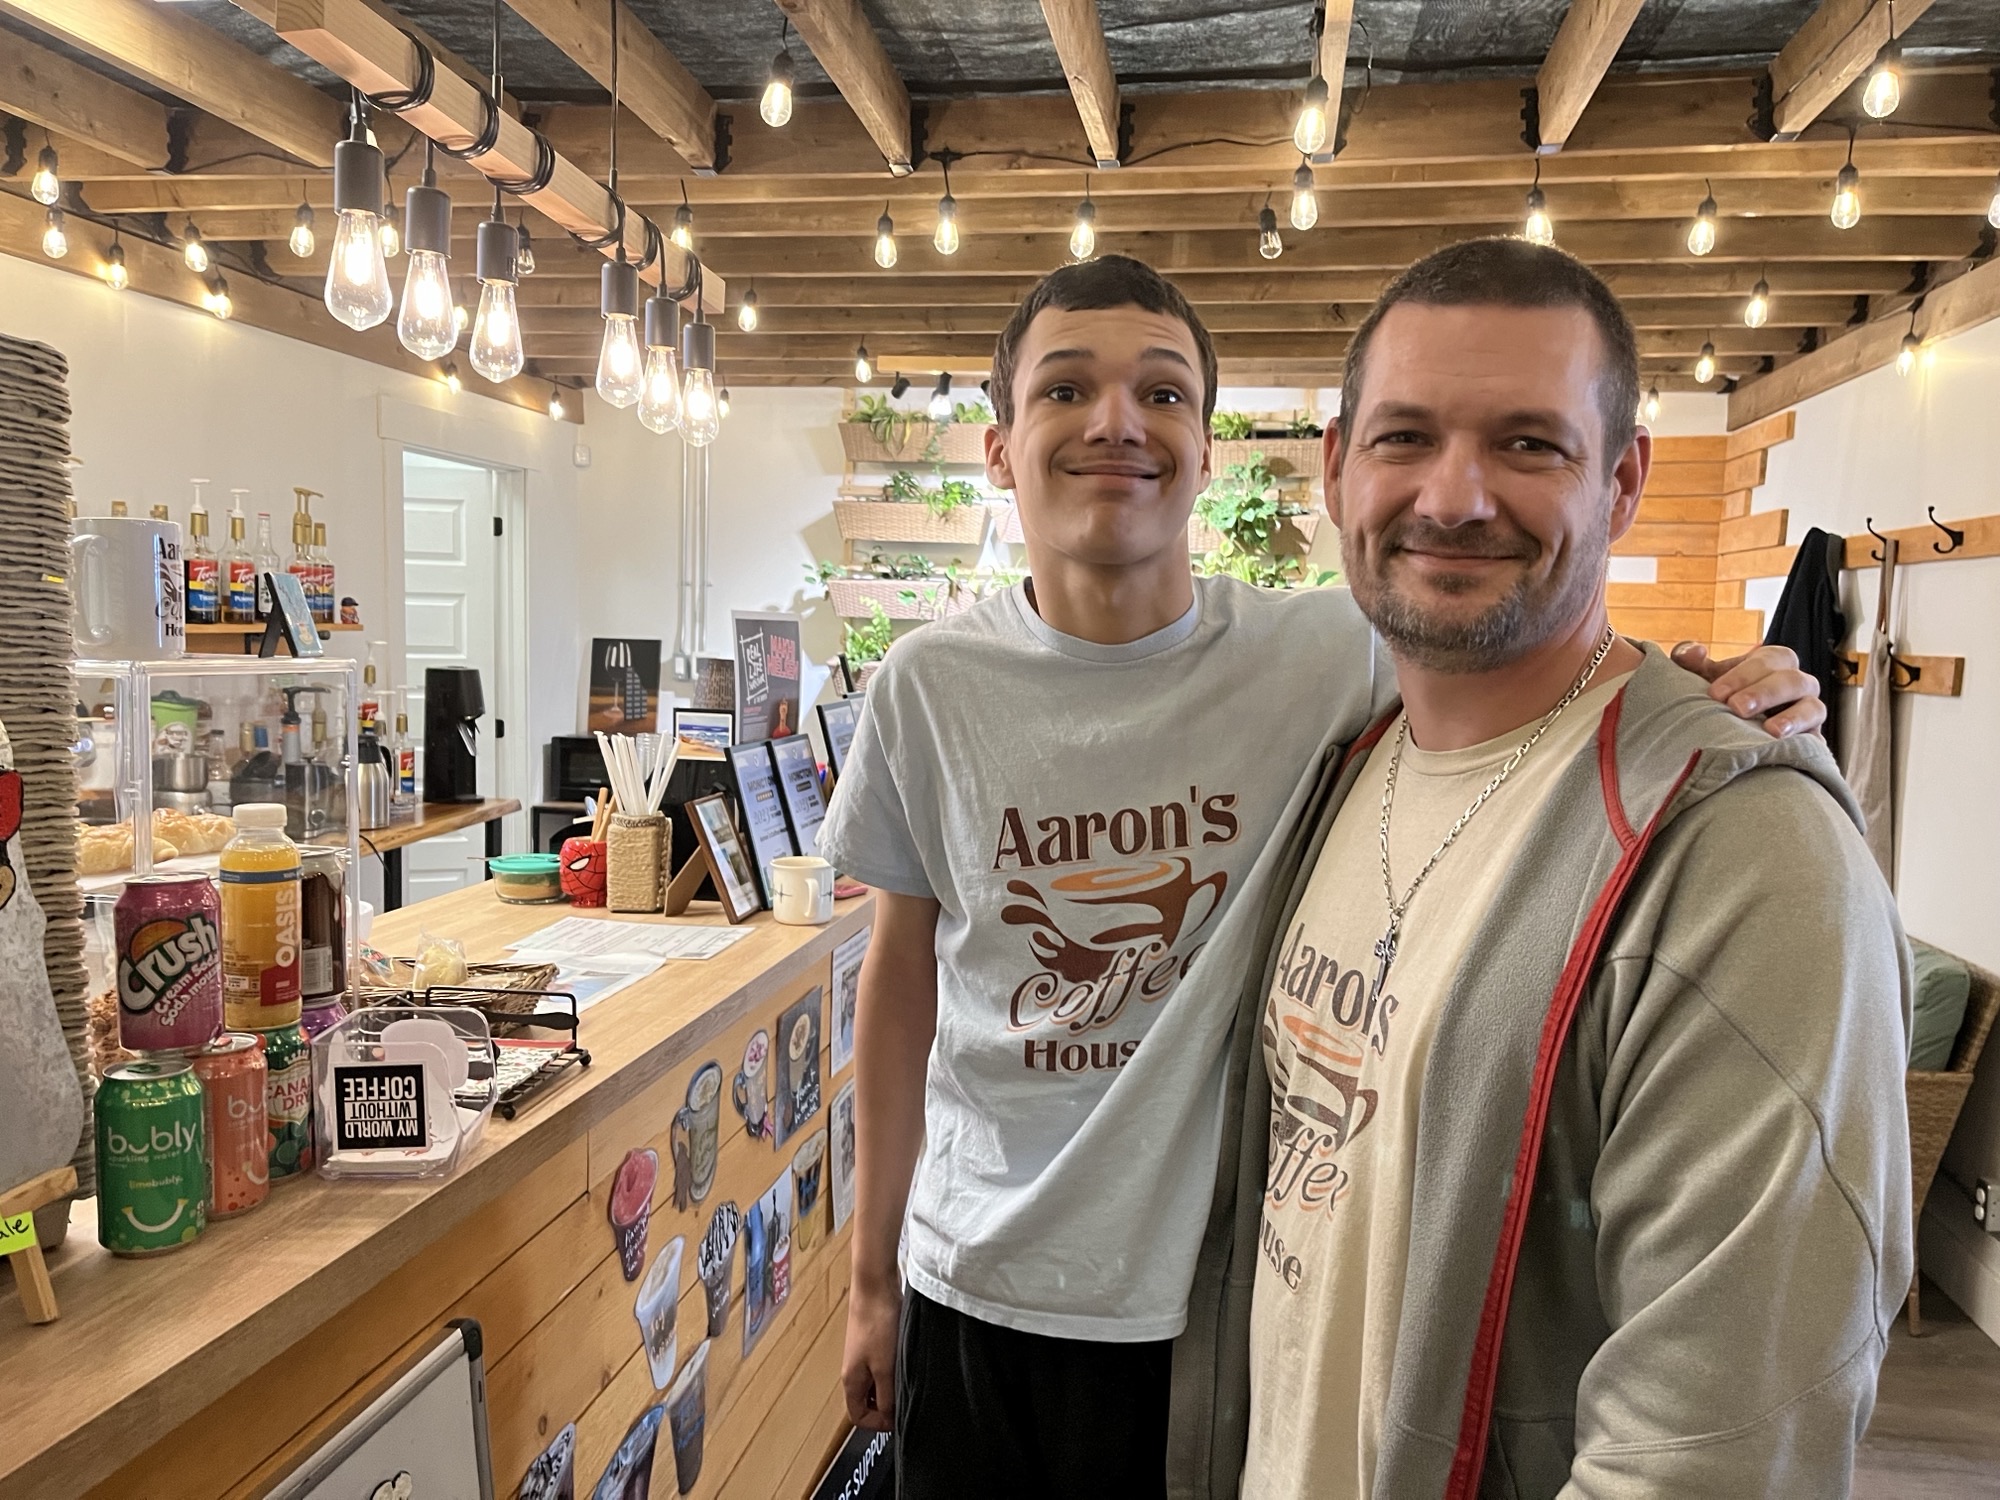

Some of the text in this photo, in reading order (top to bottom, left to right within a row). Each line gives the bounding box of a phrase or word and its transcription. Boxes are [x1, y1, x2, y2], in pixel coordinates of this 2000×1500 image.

[993, 785, 1238, 869] Aaron's
[275, 888, 297, 968] OASIS
[118, 916, 218, 1011] Crush
[154, 973, 194, 1015] Cream
[161, 994, 192, 1027] Soda
[283, 1091, 311, 1111] DRY
[342, 1075, 417, 1102] COFFEE
[350, 1101, 412, 1120] WITHOUT
[107, 1121, 197, 1154] bubly
[344, 1119, 419, 1139] MY WORLD
[1260, 1212, 1302, 1291] use
